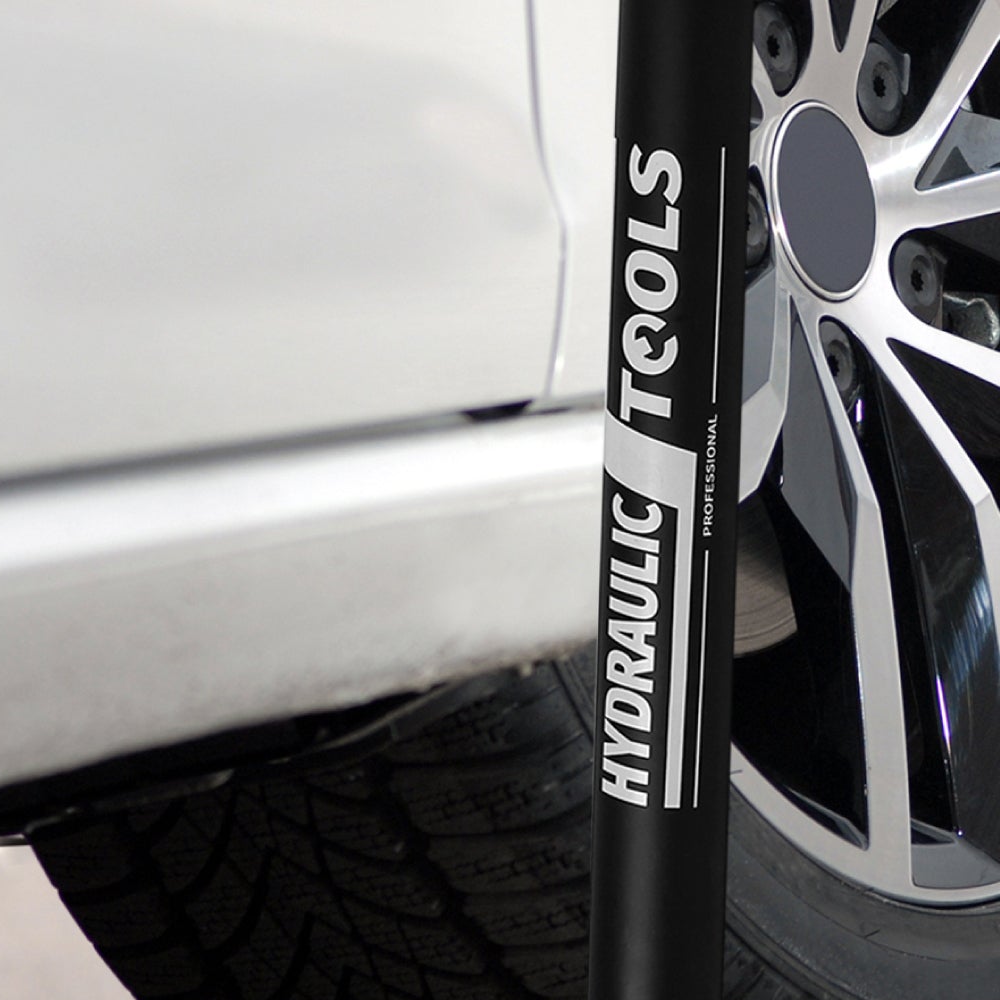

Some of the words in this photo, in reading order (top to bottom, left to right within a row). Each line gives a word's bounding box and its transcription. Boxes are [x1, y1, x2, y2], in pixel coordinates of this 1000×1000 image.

[619, 143, 683, 423] TOOLS
[702, 413, 718, 537] PROFESSIONAL
[601, 492, 663, 807] HYDRAULIC
